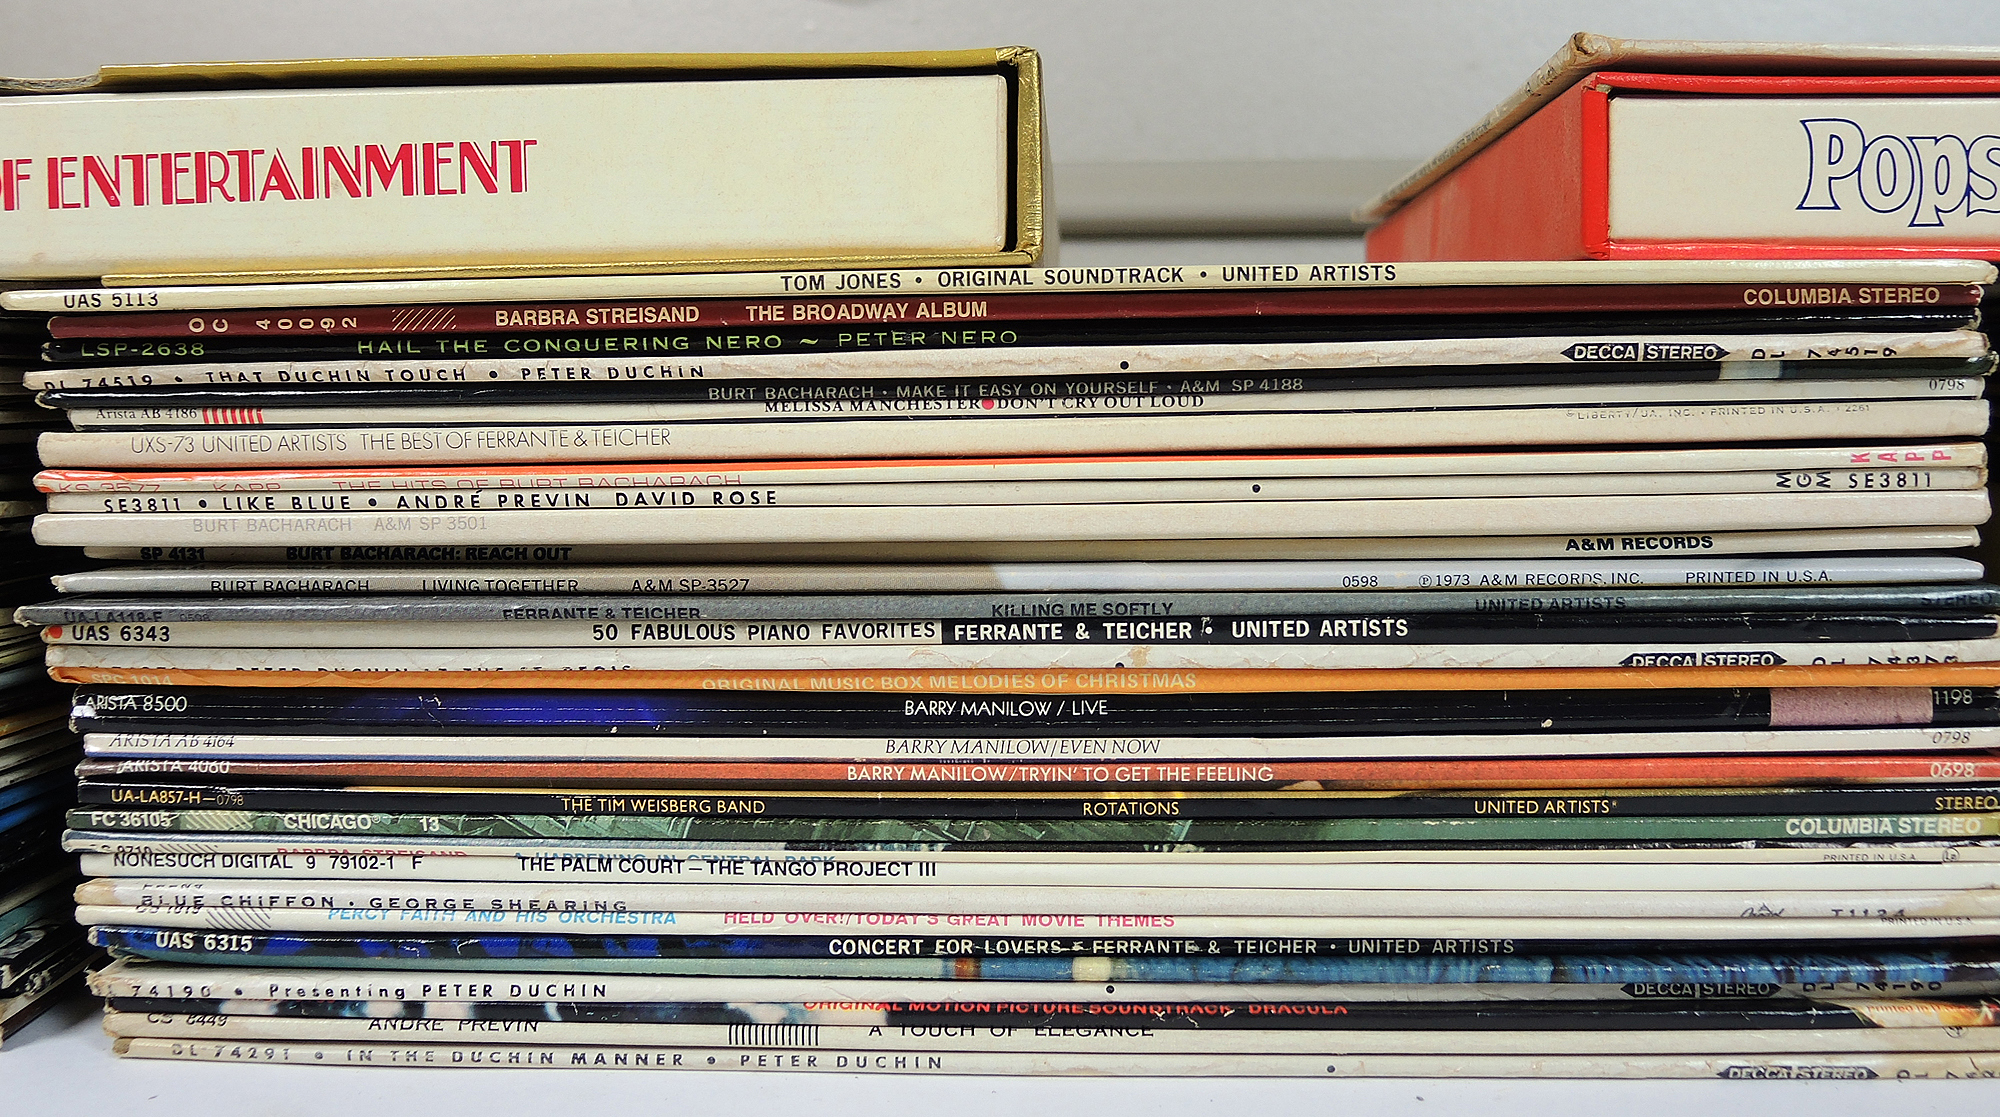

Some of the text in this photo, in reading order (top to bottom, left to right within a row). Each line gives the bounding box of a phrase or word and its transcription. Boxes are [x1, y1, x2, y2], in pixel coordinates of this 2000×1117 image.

[47, 139, 538, 211] ENTERTAINMENT
[781, 265, 1396, 291] TOM JONES ORIGINAL SOUNDTRACK UNITED ARTISTS
[64, 292, 158, 309] UAS 5113
[1743, 287, 1939, 305] COLUMBIA STEREO
[495, 300, 987, 326] BARBRA STREISAND THE BROADWAY ALBUM
[81, 330, 1018, 357] LSP-2638 HAIL THE CONQUERING NERO PETER NERO
[1573, 345, 1718, 360] DECCA STEREO
[205, 365, 704, 383] THAT DUCHIN TOUCH PETER DUCHIN
[708, 378, 1303, 401] BURT BACHARACH MAKE EASY ON YOURSELF A&M SP 4188
[764, 395, 1204, 413] MELISSA DON'T CRY LOUD
[130, 429, 671, 454] UXS-73 UNITED ARTISTS THE BEST OF FERRANTE TEICHER
[103, 491, 778, 513] SE3811 LIKE BLUE PREVIN DAVID ROSE
[194, 516, 488, 533] BURT BACHARACH A&M SP 3501
[1565, 536, 1714, 551] A&M RECORDS
[533, 547, 572, 561] OUT
[211, 570, 1780, 593] BURT BACHARACH LIVING TOGETHER A&M 0598 A&M PRINTED IN
[502, 601, 1173, 621] FERRANTE TEICHER KILLING SOFTLY
[72, 619, 1408, 643] UAS 6343 50 FABULOUS PIANO FAVORITES FERRANTE & TEICHER UNITED ARTISTS
[1703, 654, 1774, 666] STEREO
[810, 673, 1197, 692] MUSIC BOX MELODIES CHRISTMAS
[143, 696, 1108, 716] 8500 BARRY MANILOW LIVE
[885, 740, 1161, 754] BARRY NOW
[847, 766, 1274, 782] BARRY TO GET THE FEELING
[562, 796, 1998, 816] THE TIM WEISBERG BAND ROTATIONS UNITED STEREO
[91, 813, 1981, 836] FC 36105 13 COLUMBIA STEREO
[113, 854, 914, 878] NONESUCH DIGITAL 79102-1 THE PALM COURT THE TANGO PROJECT
[221, 895, 475, 909] CHIFFON GEORGE
[724, 913, 1176, 928] HELD MOVIE THEMES
[155, 931, 1514, 955] UAS 6315 CONCERT FOR LOVERS FERRANTE TEICHER UNITED ARTISTS
[269, 983, 607, 1000] Presenting PETER DUCHIN
[451, 1051, 943, 1070] DUCHIN MANNER PETER DUCHIN
